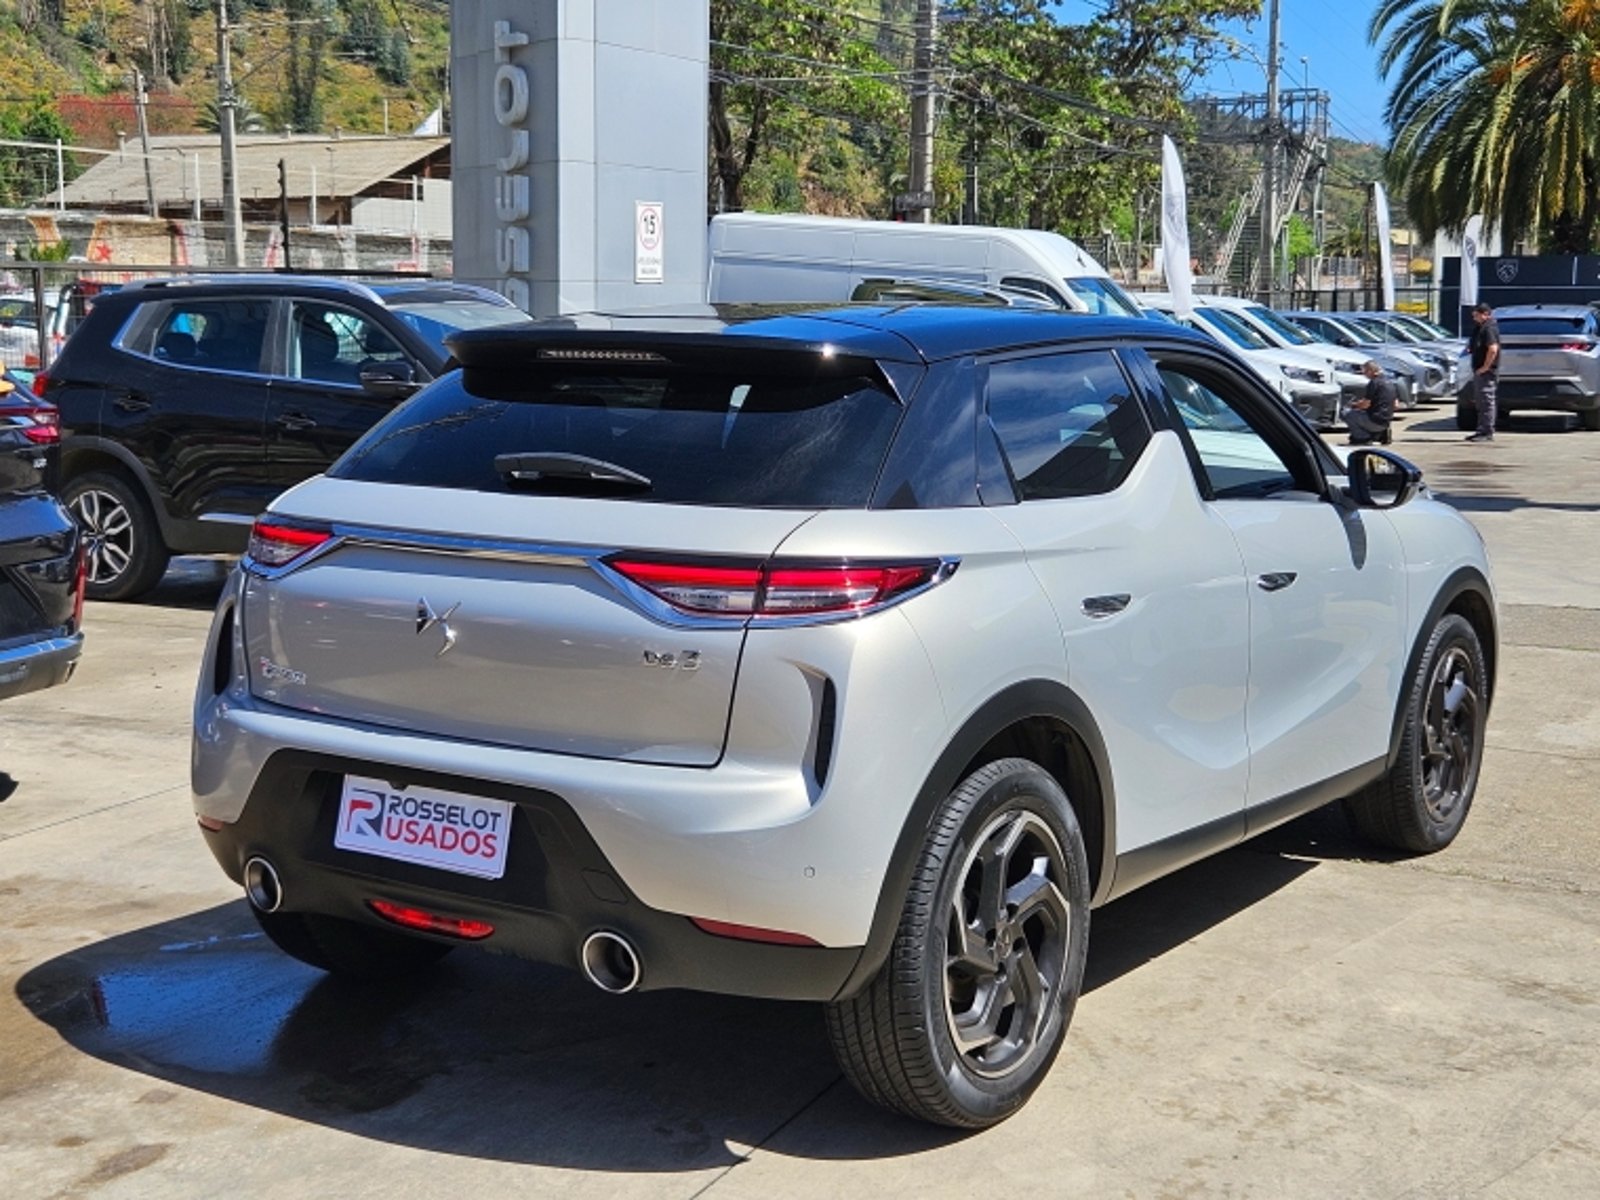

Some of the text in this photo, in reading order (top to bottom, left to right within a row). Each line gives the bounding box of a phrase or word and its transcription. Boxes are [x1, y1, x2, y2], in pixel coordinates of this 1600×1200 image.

[643, 214, 656, 235] 15
[681, 650, 702, 671] 3
[387, 795, 502, 832] ROSSELOT
[385, 816, 498, 858] USADOS
